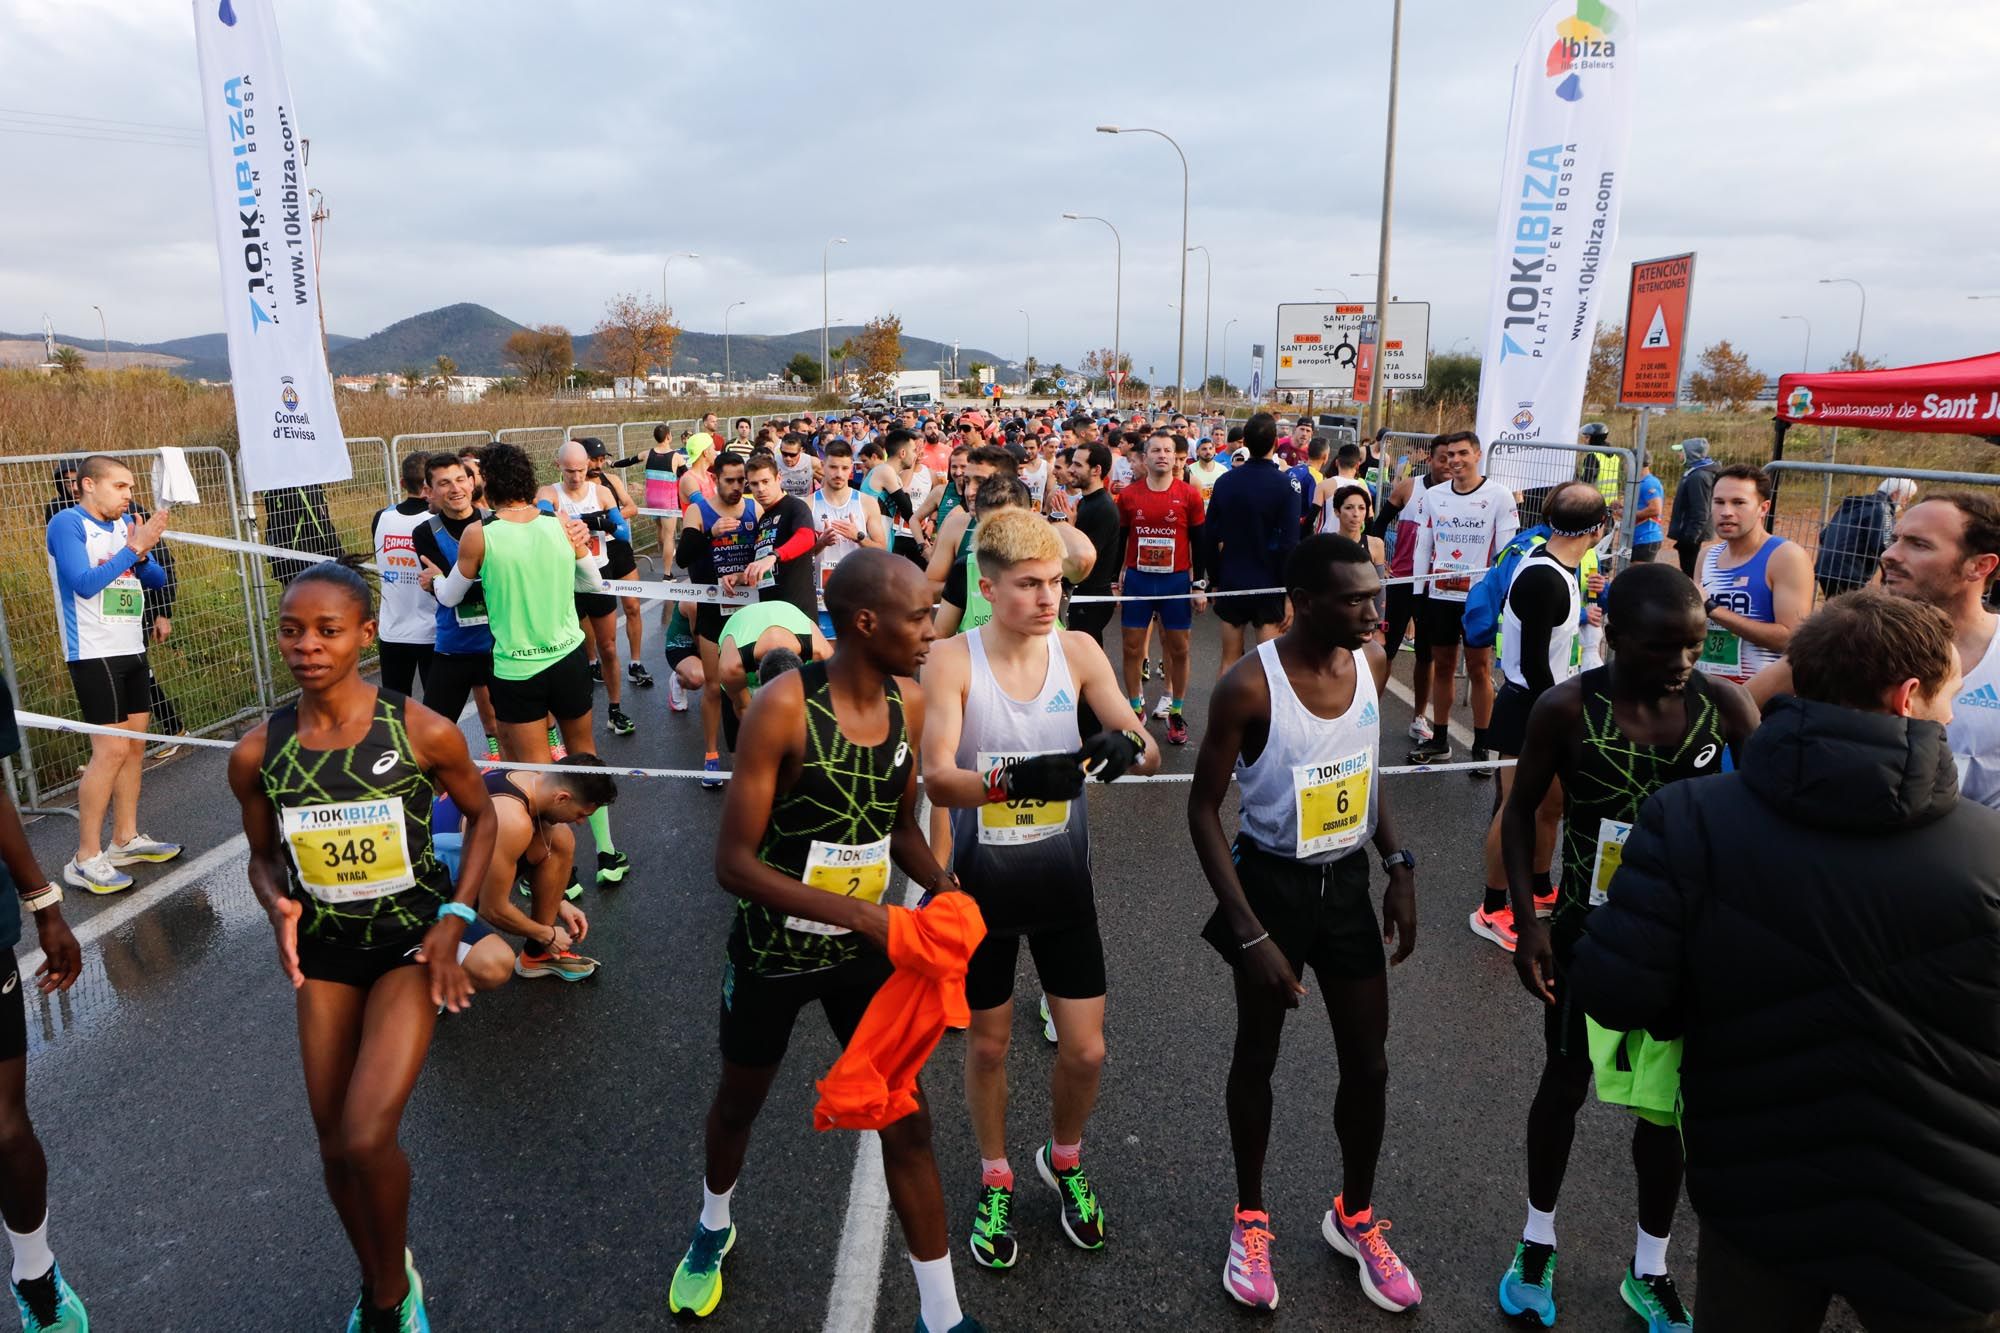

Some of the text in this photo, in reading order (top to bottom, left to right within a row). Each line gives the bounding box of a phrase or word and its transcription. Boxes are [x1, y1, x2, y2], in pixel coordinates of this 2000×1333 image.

[1562, 35, 1615, 58] Ibiza
[243, 75, 257, 152] BOSSA
[224, 76, 265, 293] 10KIBIZA
[278, 105, 307, 305] www.10kibiza.com
[1504, 144, 1563, 329] 10KIBIZA
[1533, 144, 1577, 358] PLATJA D'EN BOSSA
[1571, 171, 1614, 341] www.10kibiza.com
[262, 241, 279, 324] PLATJA
[1637, 278, 1686, 293] RETENCIONES
[1351, 314, 1376, 322] JORDI
[1297, 357, 1332, 365] aeroport
[1896, 401, 1917, 418] de
[1921, 393, 1978, 419] Sant
[273, 427, 316, 440] d'Eivissa
[387, 556, 417, 567] VIVA
[120, 594, 133, 607] 50
[669, 587, 702, 596] d'Eivissa
[511, 637, 576, 657] ATLETISME INCA
[1711, 636, 1724, 652] 38
[1316, 752, 1367, 779] 10KIBIZA
[1336, 790, 1349, 814] 6
[311, 804, 390, 823] 10KIBIZA
[1015, 813, 1036, 825] EMIL
[1322, 817, 1349, 831] COSMAS
[322, 838, 377, 868] 348
[337, 870, 368, 882] NYAGA
[847, 877, 860, 897] 2
